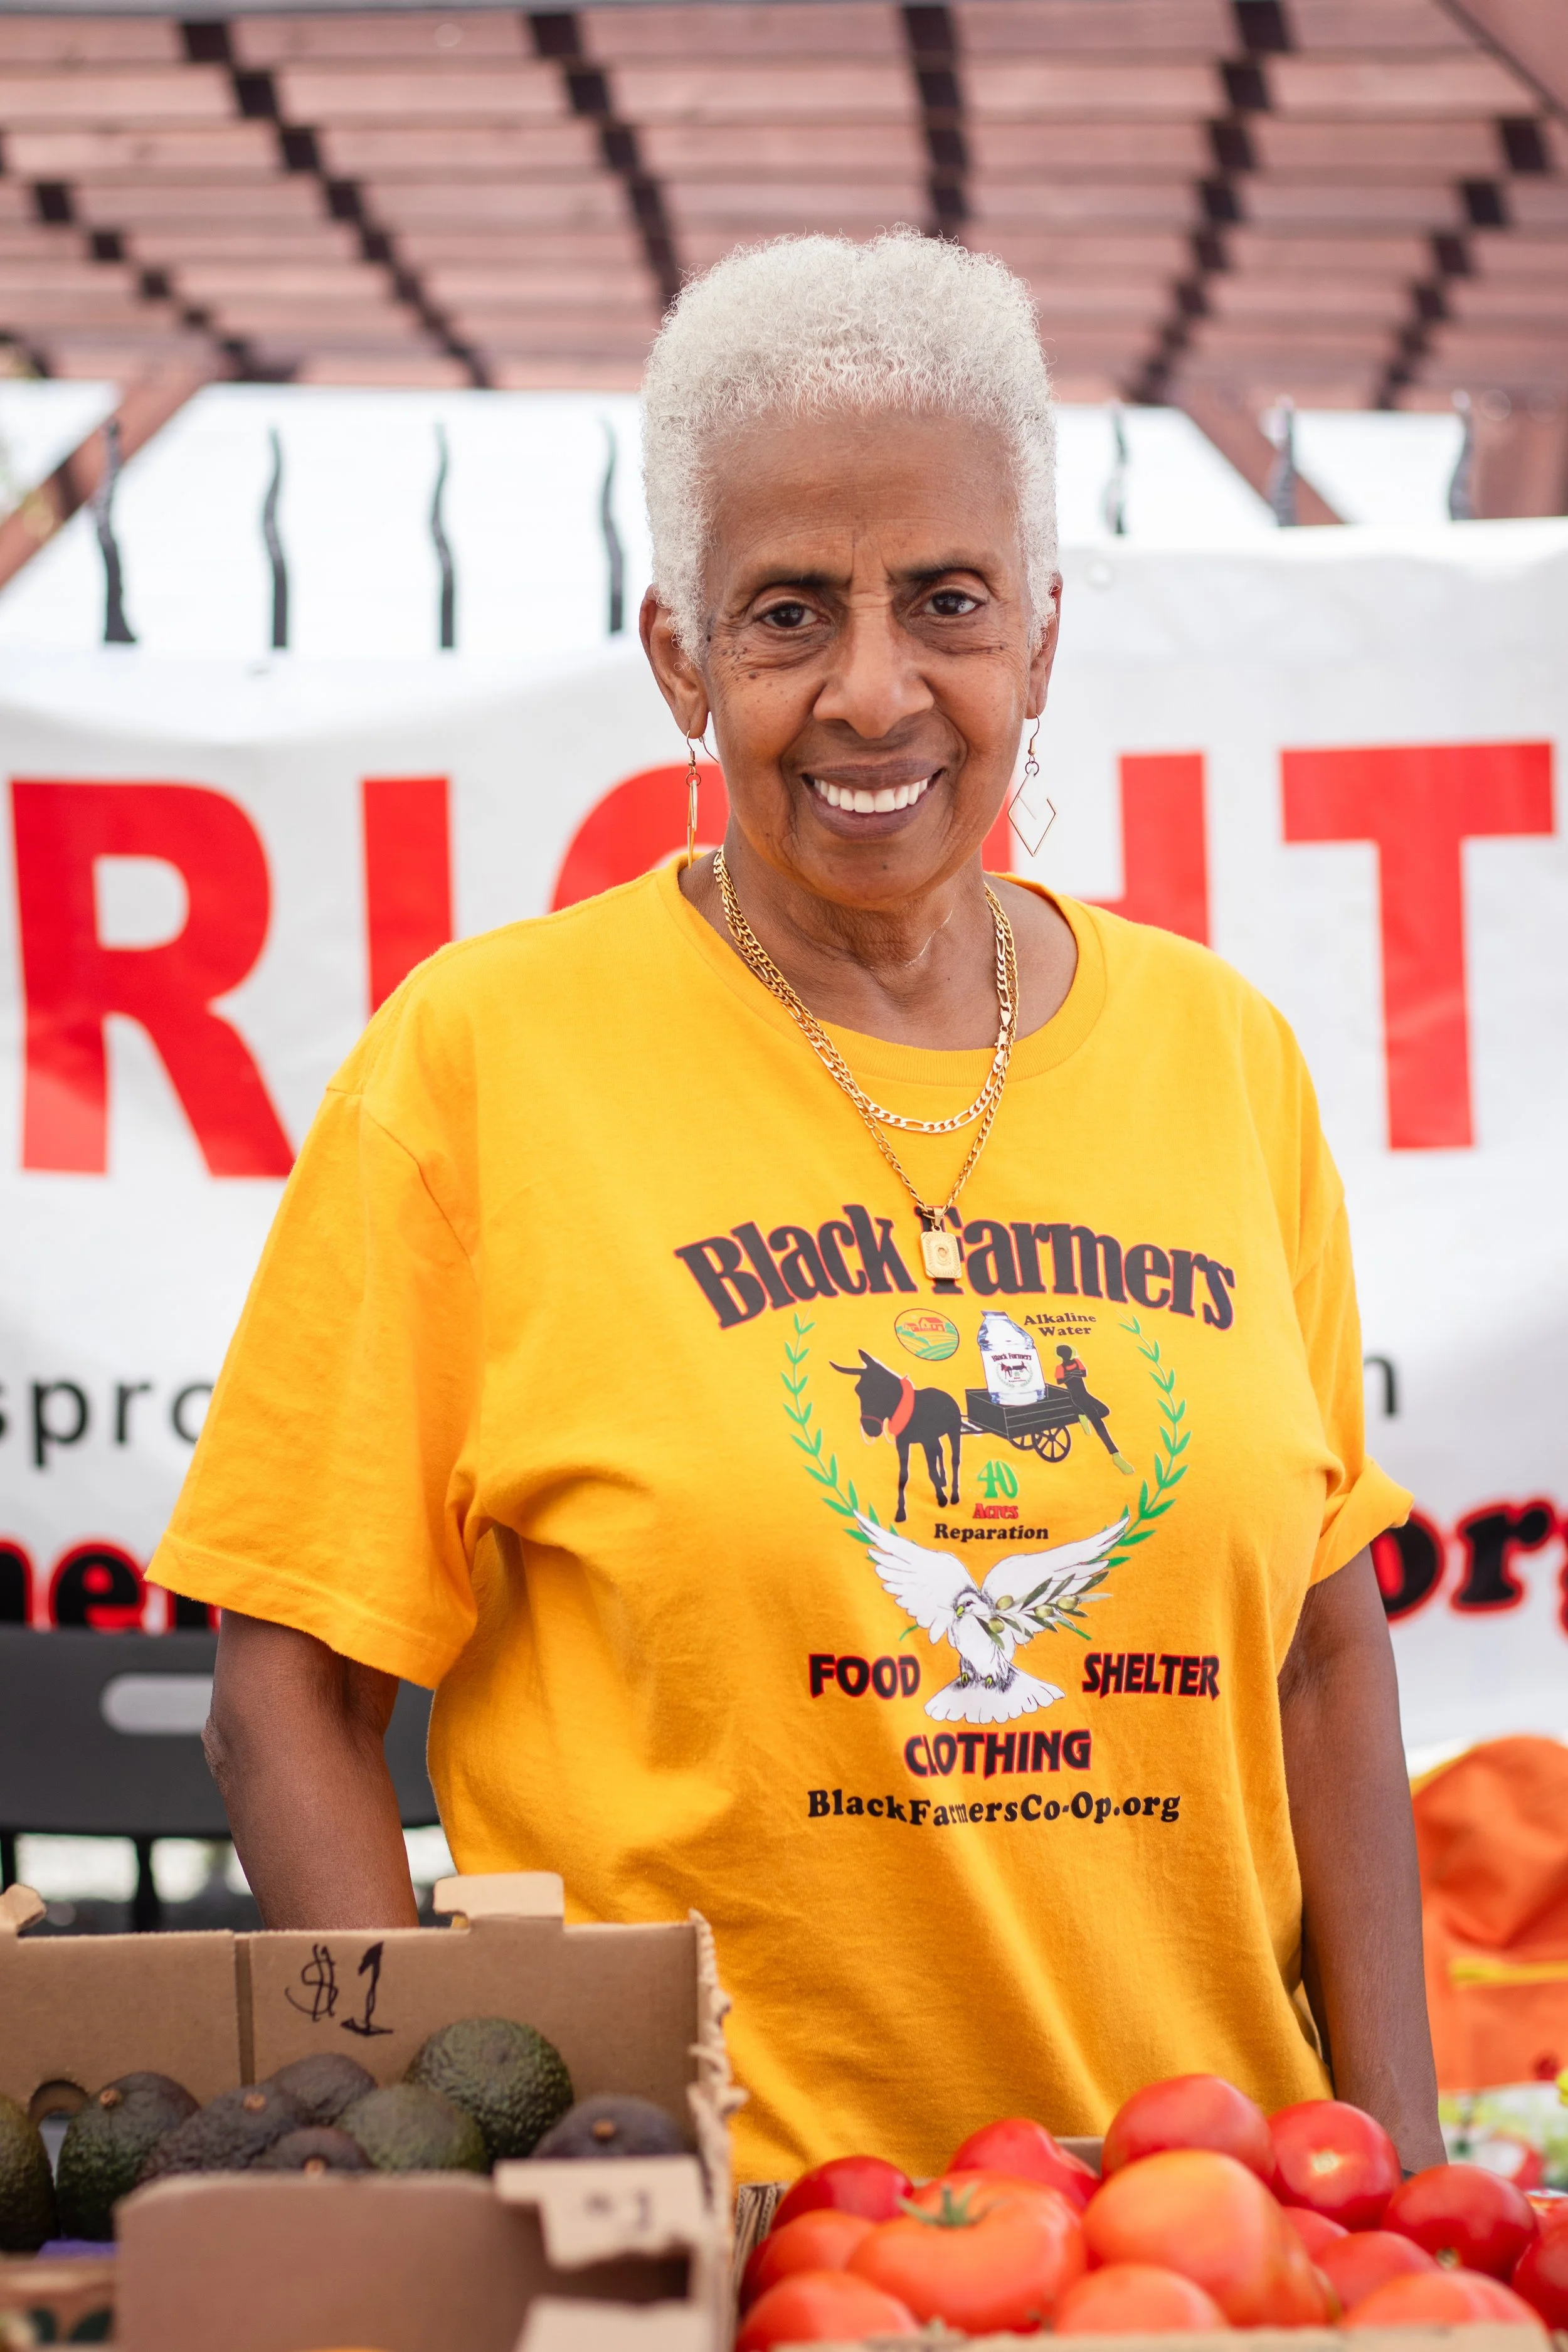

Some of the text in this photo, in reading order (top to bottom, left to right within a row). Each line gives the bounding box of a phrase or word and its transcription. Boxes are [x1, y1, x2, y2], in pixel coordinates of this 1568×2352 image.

[10, 742, 1556, 1179] RIT
[673, 1204, 918, 1330] Black
[1024, 1313, 1096, 1325] Alkaline
[1038, 1326, 1091, 1337] Water
[991, 1353, 1008, 1362] Black
[977, 1459, 1019, 1499] 40
[972, 1503, 1019, 1519] Acres
[934, 1523, 1049, 1543] Reparation
[1369, 1496, 1568, 1640] or
[808, 1654, 921, 1700] FOOD
[1082, 1652, 1220, 1701] SHELTER
[903, 1729, 1092, 1780] CLOTHING
[807, 1789, 1181, 1826] BlackFarmersCo-Op.org
[284, 1941, 394, 2037] $1
